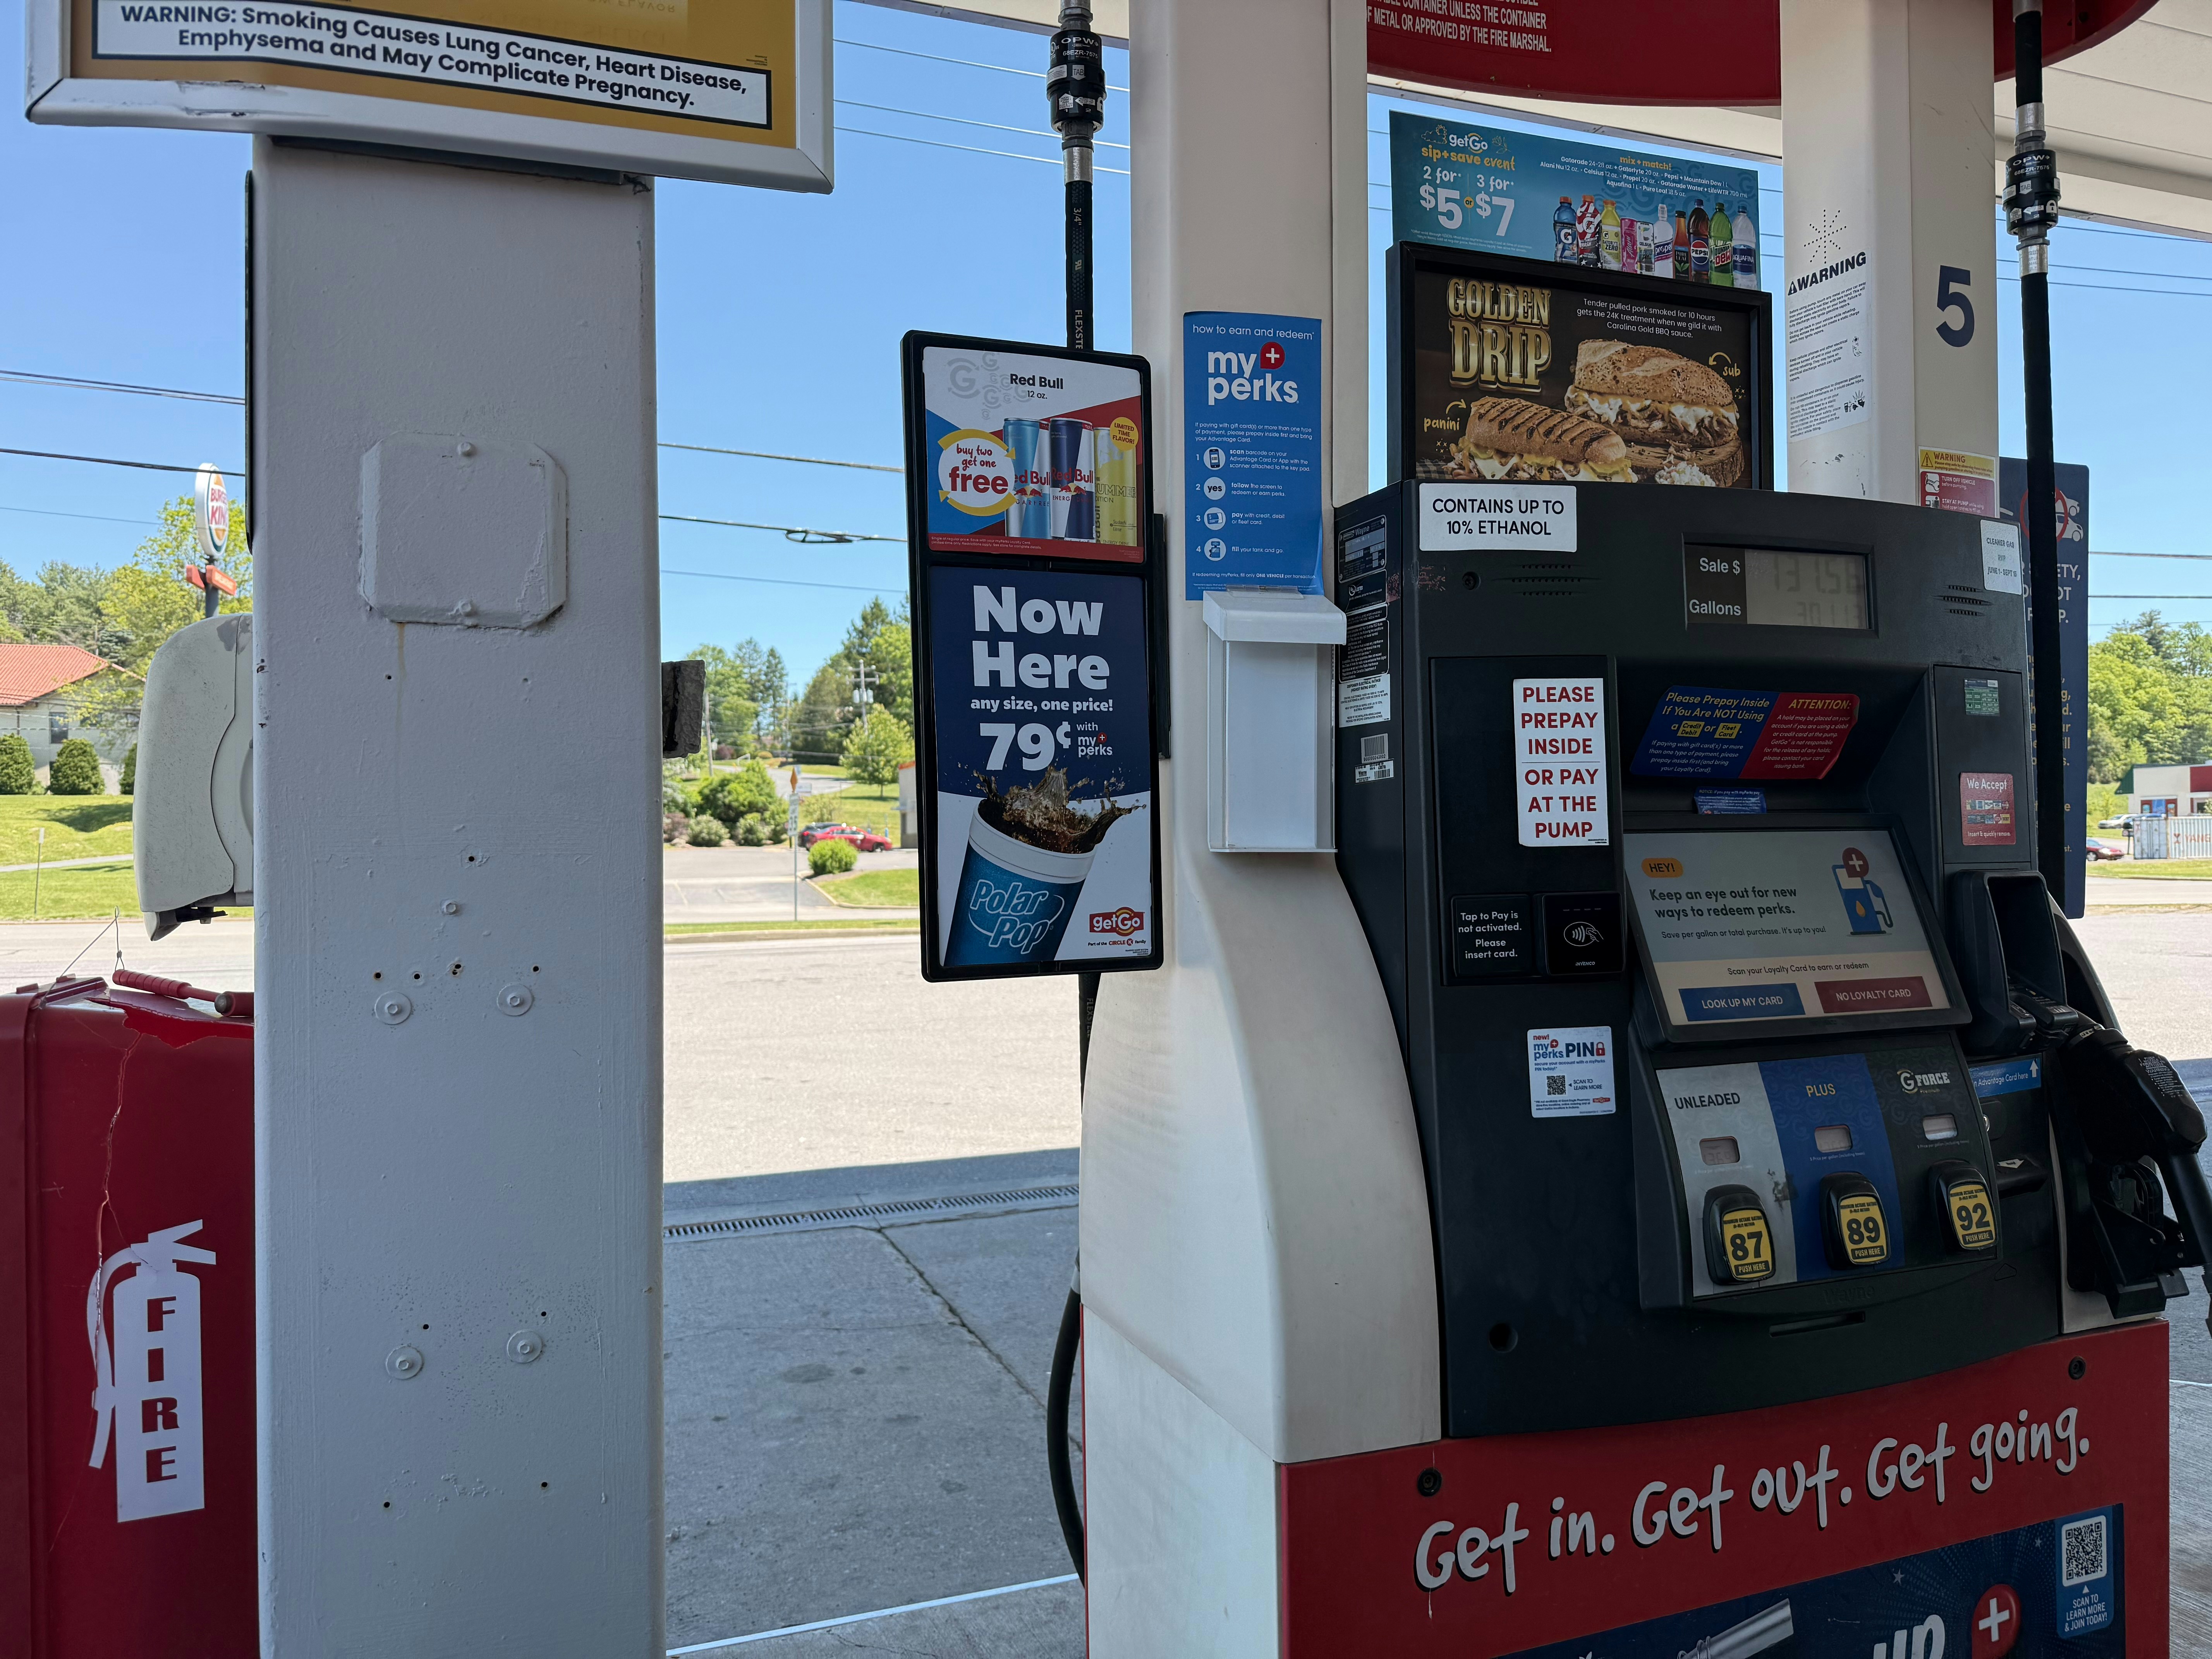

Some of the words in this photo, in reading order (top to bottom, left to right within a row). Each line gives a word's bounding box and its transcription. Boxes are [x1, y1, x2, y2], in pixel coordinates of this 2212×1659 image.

[1374, 9, 1400, 29] METAL
[1401, 14, 1413, 31] OR
[1415, 16, 1458, 39] APPROVED
[1460, 24, 1471, 41] BY
[1472, 27, 1488, 44] THE
[1491, 29, 1508, 47] FIRE
[1510, 32, 1551, 52] MARSHAL.
[1061, 37, 1094, 45] OPW
[121, 6, 236, 22] WARNING:
[243, 8, 347, 39] Smoking
[354, 20, 440, 46] Causes
[447, 32, 500, 60] Lung
[506, 41, 590, 71] Cancer,
[597, 55, 655, 79] Heart
[661, 65, 746, 97] Disease,
[1063, 50, 1097, 59] 68EZR-7575
[179, 29, 323, 54] Emphysema
[330, 43, 376, 61] and
[383, 46, 433, 73] May
[438, 50, 569, 87] Complicate
[575, 72, 694, 109] Pregnancy.
[1449, 133, 1488, 150] getGo
[1484, 156, 1515, 170] event
[1420, 182, 1462, 229] $5
[1476, 191, 1514, 236] $7
[1797, 251, 1866, 292] WARNING
[1447, 279, 1551, 329] GOLDEN
[1584, 299, 1607, 307] Tender
[1697, 313, 1715, 321] hours
[1936, 265, 1975, 347] 5
[1607, 322, 1636, 331] Carolina
[1656, 328, 1669, 336] BBQ
[1621, 314, 1655, 325] treatment
[1688, 322, 1700, 330] gild
[1193, 324, 1213, 333] how
[1216, 325, 1226, 334] to
[1254, 328, 1273, 337] and
[1449, 320, 1551, 392] DRIP
[1208, 352, 1257, 379] my
[1723, 363, 1740, 376] sub
[1010, 374, 1036, 386] Red
[1039, 376, 1063, 389] Bull
[1208, 373, 1299, 405] perks
[1424, 417, 1460, 432] panini
[957, 443, 973, 458] buy
[976, 445, 992, 456] two
[1934, 452, 1965, 464] WARNING
[962, 457, 977, 471] get
[949, 466, 1008, 494] free
[1433, 498, 1513, 514] CONTAINS
[1519, 500, 1539, 514] UP
[1542, 500, 1564, 514] TO
[1447, 520, 1473, 534] 10%
[1479, 520, 1551, 535] ETHANOL
[1700, 558, 1728, 573] Sale
[1733, 560, 1740, 575] $
[974, 586, 1103, 635] Now
[1689, 600, 1741, 615] Gallons
[972, 641, 1109, 690] Here
[1523, 687, 1594, 702] PLEASE
[971, 699, 1000, 712] any
[1003, 696, 1037, 712] size,
[1041, 701, 1069, 710] one
[1073, 697, 1113, 714] price!
[1788, 699, 1851, 709] ATTENTION:
[1077, 722, 1098, 731] with
[1522, 712, 1598, 728] PREPAY
[1078, 737, 1096, 747] my
[1528, 738, 1592, 754] INSIDE
[1079, 744, 1113, 758] perks
[1525, 769, 1553, 785] OR
[1560, 769, 1599, 785] PAY
[1967, 778, 1979, 789] We
[1981, 778, 2007, 793] Accept
[1528, 797, 1553, 812] AT
[1559, 796, 1596, 812] THE
[1535, 822, 1592, 838] PUMP
[1649, 863, 1675, 872] HEY!
[970, 879, 1049, 915] Polar
[1649, 889, 1682, 903] Keep
[1685, 891, 1702, 900] an
[1705, 891, 1726, 902] eye
[1730, 888, 1749, 898] out
[1752, 886, 1769, 898] for
[1772, 889, 1796, 897] new
[1460, 913, 1477, 922] Tap
[1492, 912, 1508, 921] Pay
[1654, 909, 1688, 921] ways
[1690, 906, 1704, 917] to
[1707, 904, 1755, 916] redeem
[1757, 902, 1795, 918] perks.
[1093, 913, 1140, 931] getGo
[1475, 922, 1522, 932] activated.
[988, 916, 1051, 954] Pop
[1476, 939, 1506, 947] Please
[1494, 949, 1517, 957] card.
[1806, 1084, 1835, 1097] PLUS
[1674, 1093, 1740, 1109] UNLEADED
[1956, 1203, 1990, 1231] 92
[1847, 1216, 1880, 1245] 89
[1730, 1231, 1762, 1261] 87
[1738, 1264, 1751, 1272] PUSH
[1752, 1263, 1765, 1271] HERE
[142, 1296, 179, 1483] FIRE
[1416, 1503, 1529, 1592] Get
[1551, 1497, 1614, 1557] in.
[1633, 1465, 1734, 1549] Get
[1752, 1445, 1852, 1527] out.
[1868, 1422, 1955, 1502] Get
[1971, 1407, 2089, 1490] going.
[2073, 1596, 2090, 1609] SCAN
[2090, 1594, 2098, 1603] TO
[2066, 1607, 2086, 1621] LEARN
[2087, 1601, 2105, 1614] MORE
[2064, 1623, 2069, 1632] &
[2070, 1617, 2085, 1630] JOIN
[2086, 1611, 2107, 1625] TODAY!
